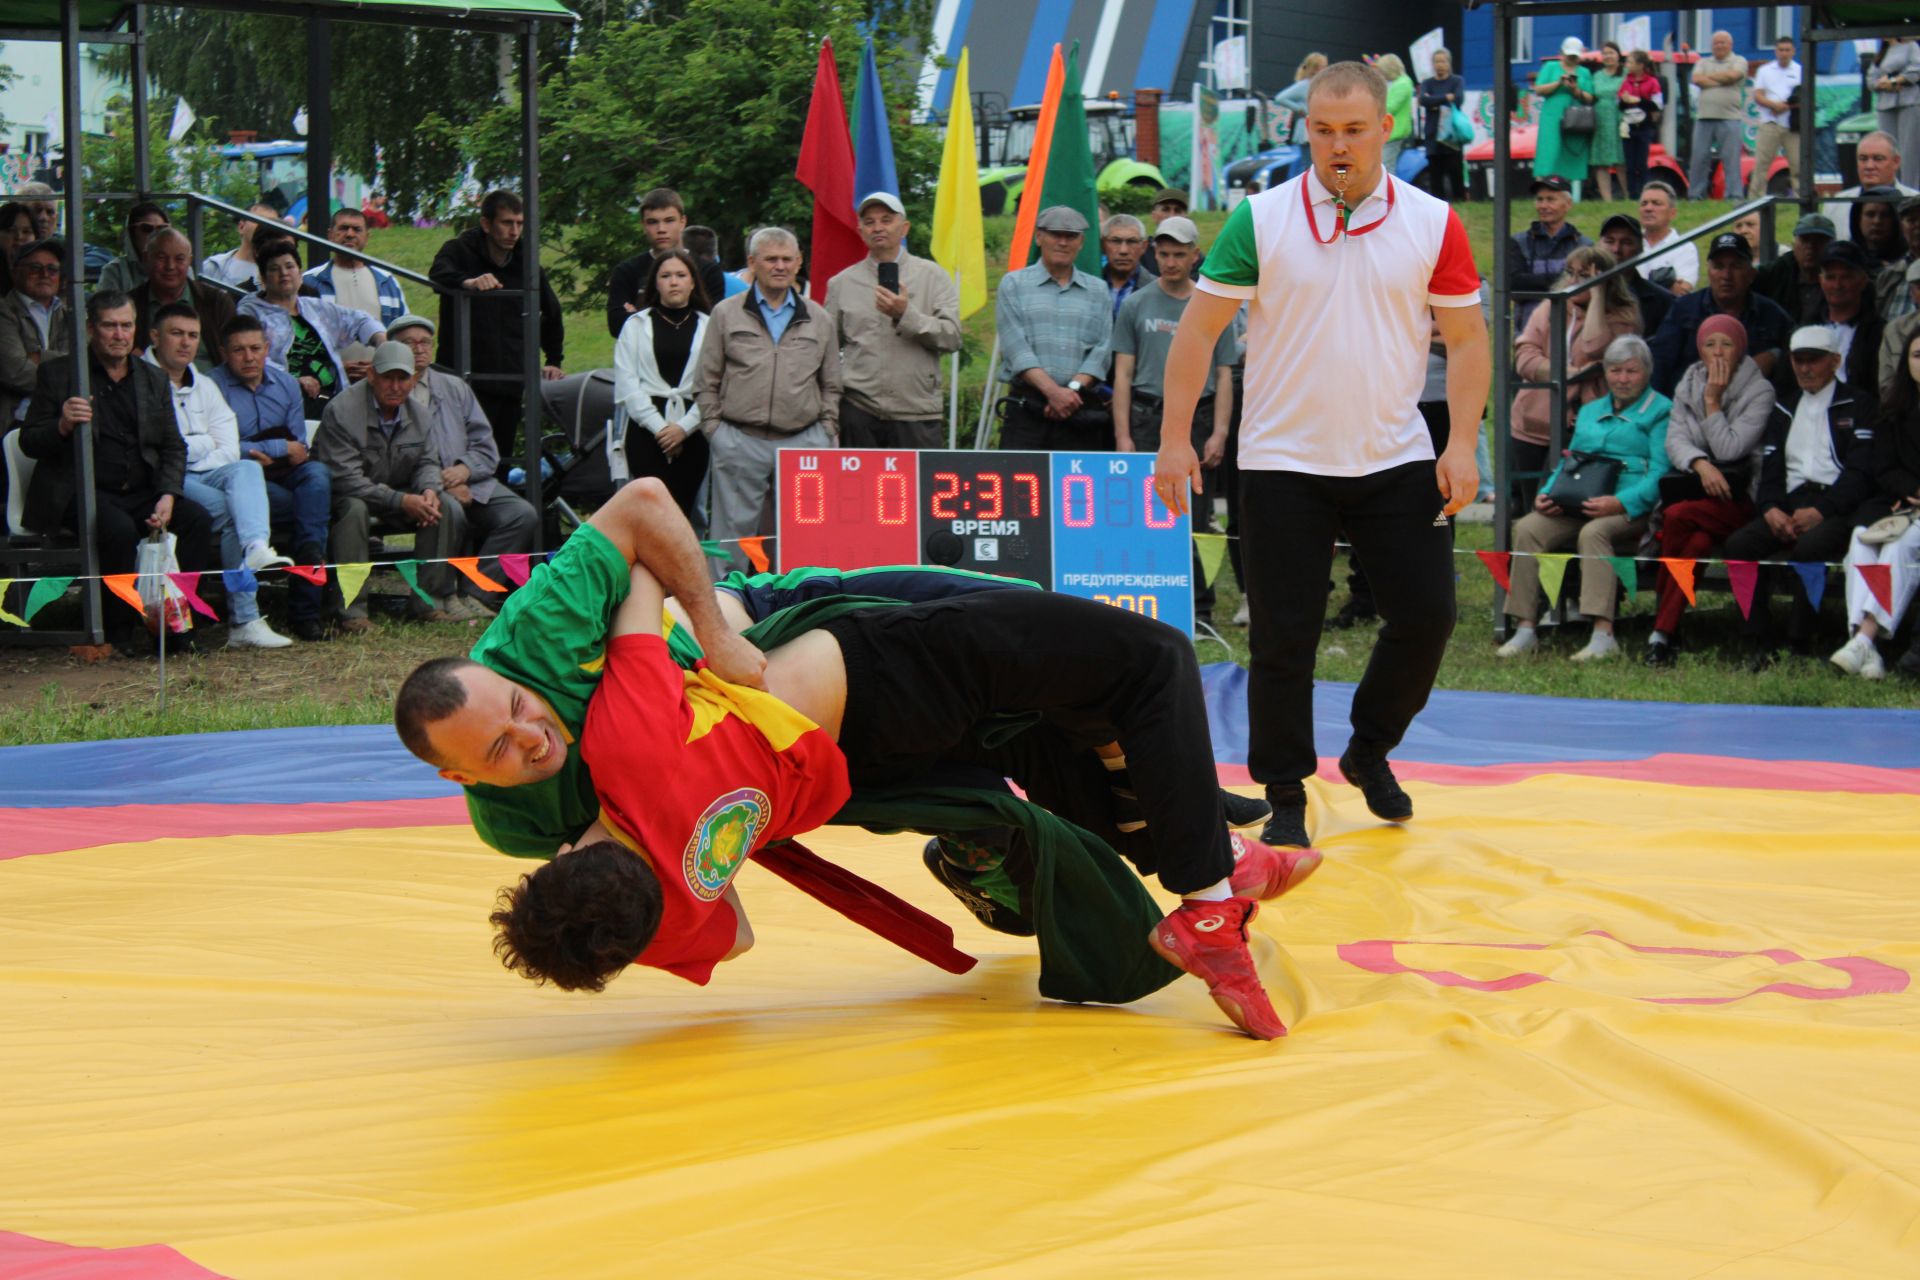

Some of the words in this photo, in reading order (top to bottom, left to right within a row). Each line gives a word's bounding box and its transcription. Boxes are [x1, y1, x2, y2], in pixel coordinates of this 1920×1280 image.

[800, 456, 818, 470] Ш
[841, 456, 861, 471] Ю
[884, 457, 898, 471] К
[1071, 459, 1083, 474] К
[1109, 460, 1128, 474] Ю
[795, 473, 824, 524] 0
[877, 474, 906, 525] 0
[931, 473, 1040, 518] 2:37
[1062, 475, 1095, 528] 0
[951, 520, 1020, 535] ВРЕМЯ
[1063, 573, 1189, 588] ПРЕДУПРЕЖДЕНИЕ
